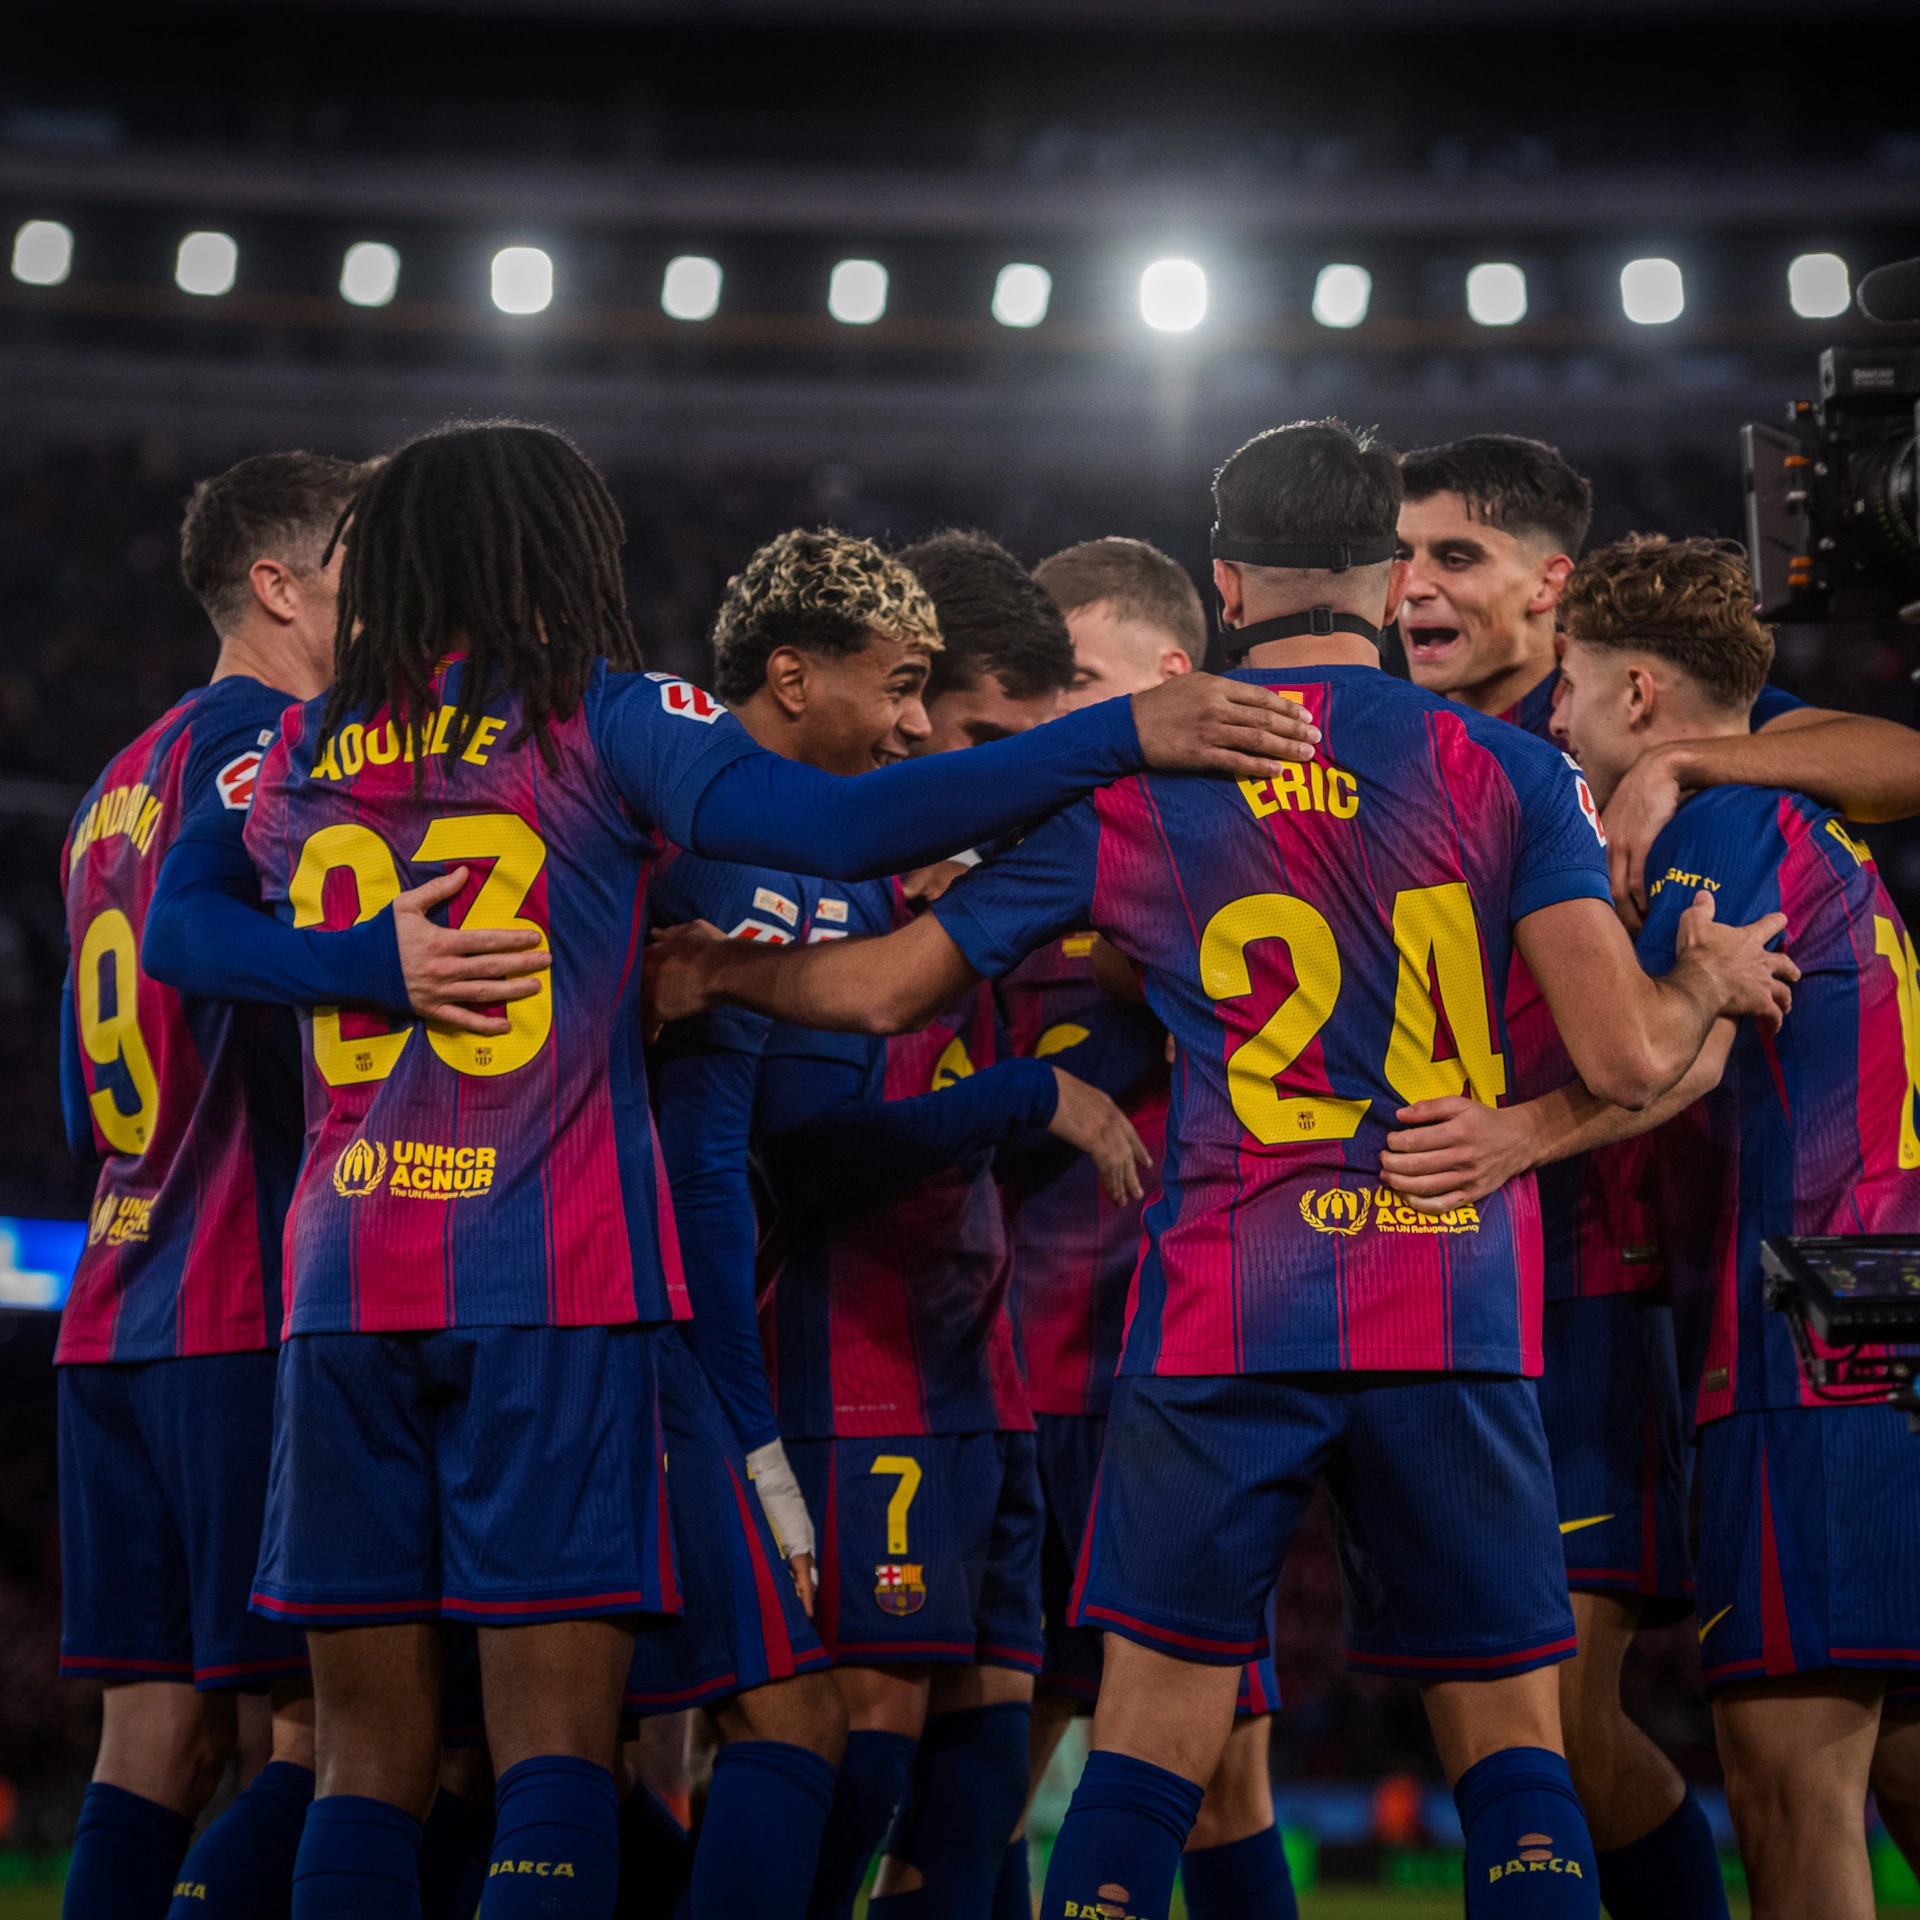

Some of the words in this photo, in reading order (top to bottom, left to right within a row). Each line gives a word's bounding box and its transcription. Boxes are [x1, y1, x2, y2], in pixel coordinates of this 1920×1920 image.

[1236, 760, 1360, 820] ERIC
[288, 812, 554, 1087] 23
[78, 908, 160, 1156] 9
[1199, 880, 1507, 1146] 24
[1873, 913, 1920, 1171] 1
[389, 1164, 495, 1191] ACNUR
[390, 1187, 407, 1198] The
[408, 1188, 423, 1199] UN
[423, 1190, 459, 1201] Refugee
[459, 1187, 491, 1199] Agency
[392, 1140, 497, 1169] UNHCR
[1377, 1225, 1396, 1233] The
[1396, 1225, 1411, 1234] UN
[1411, 1226, 1448, 1235] Refugee
[1449, 1225, 1481, 1234] Agency
[869, 1454, 923, 1556] 7
